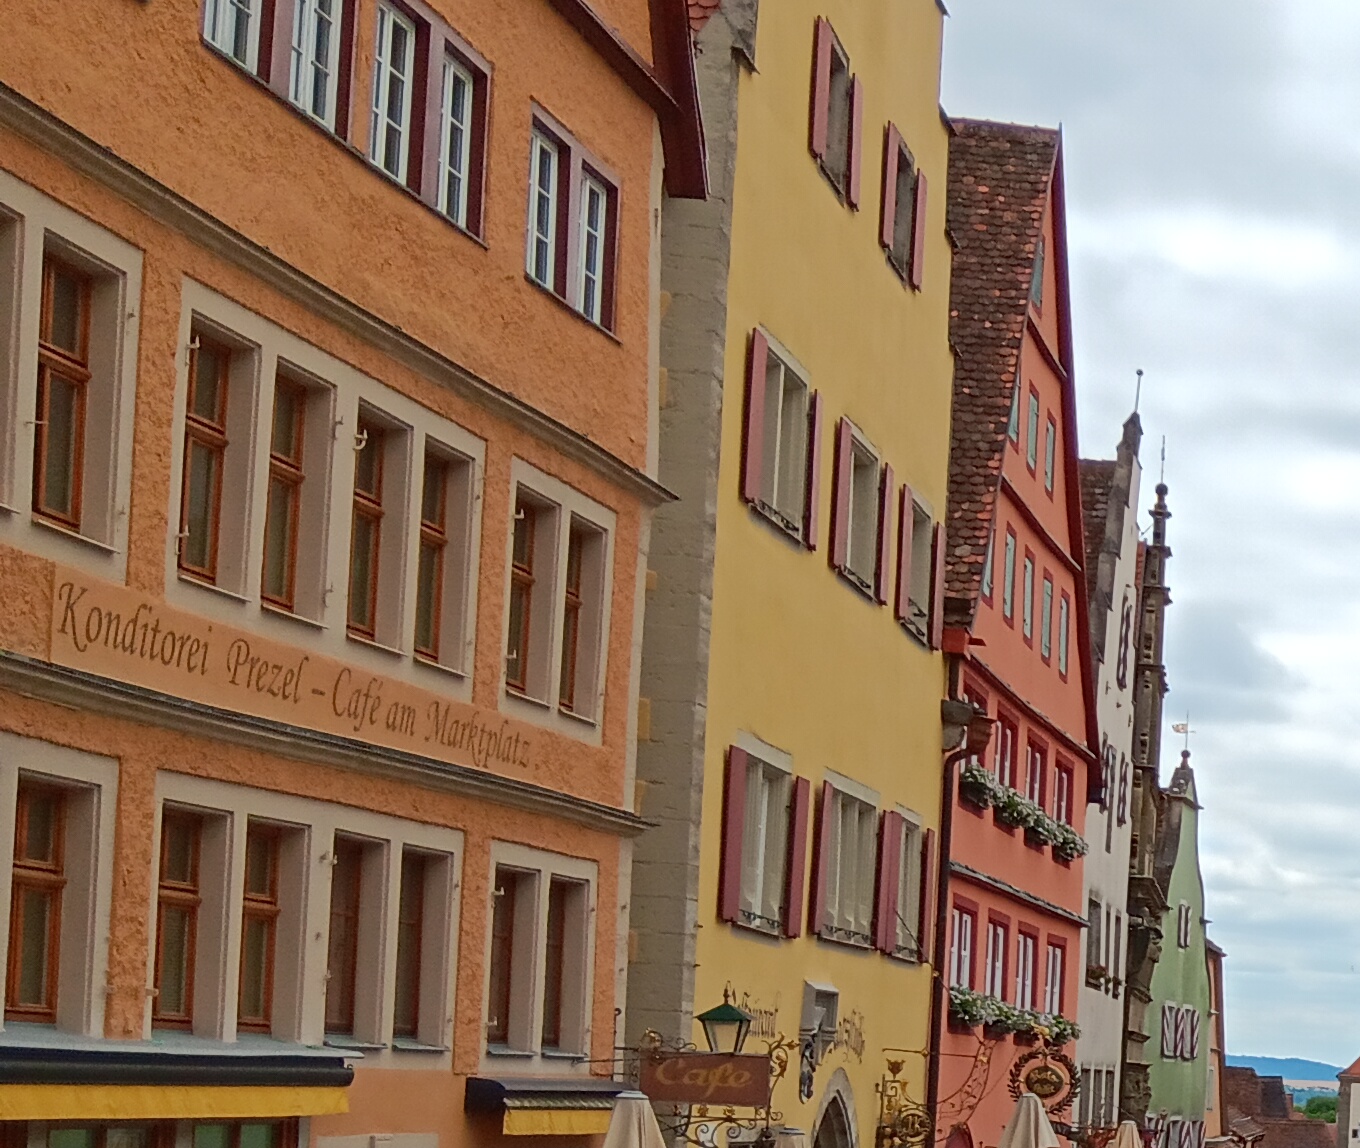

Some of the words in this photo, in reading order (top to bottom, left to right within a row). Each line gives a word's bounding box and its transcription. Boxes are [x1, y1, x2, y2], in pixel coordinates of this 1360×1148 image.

[57, 581, 213, 676] Konditorei
[226, 637, 310, 705] Prezel
[332, 666, 384, 732] Café
[386, 700, 417, 737] am
[424, 699, 531, 769] Marktplatz
